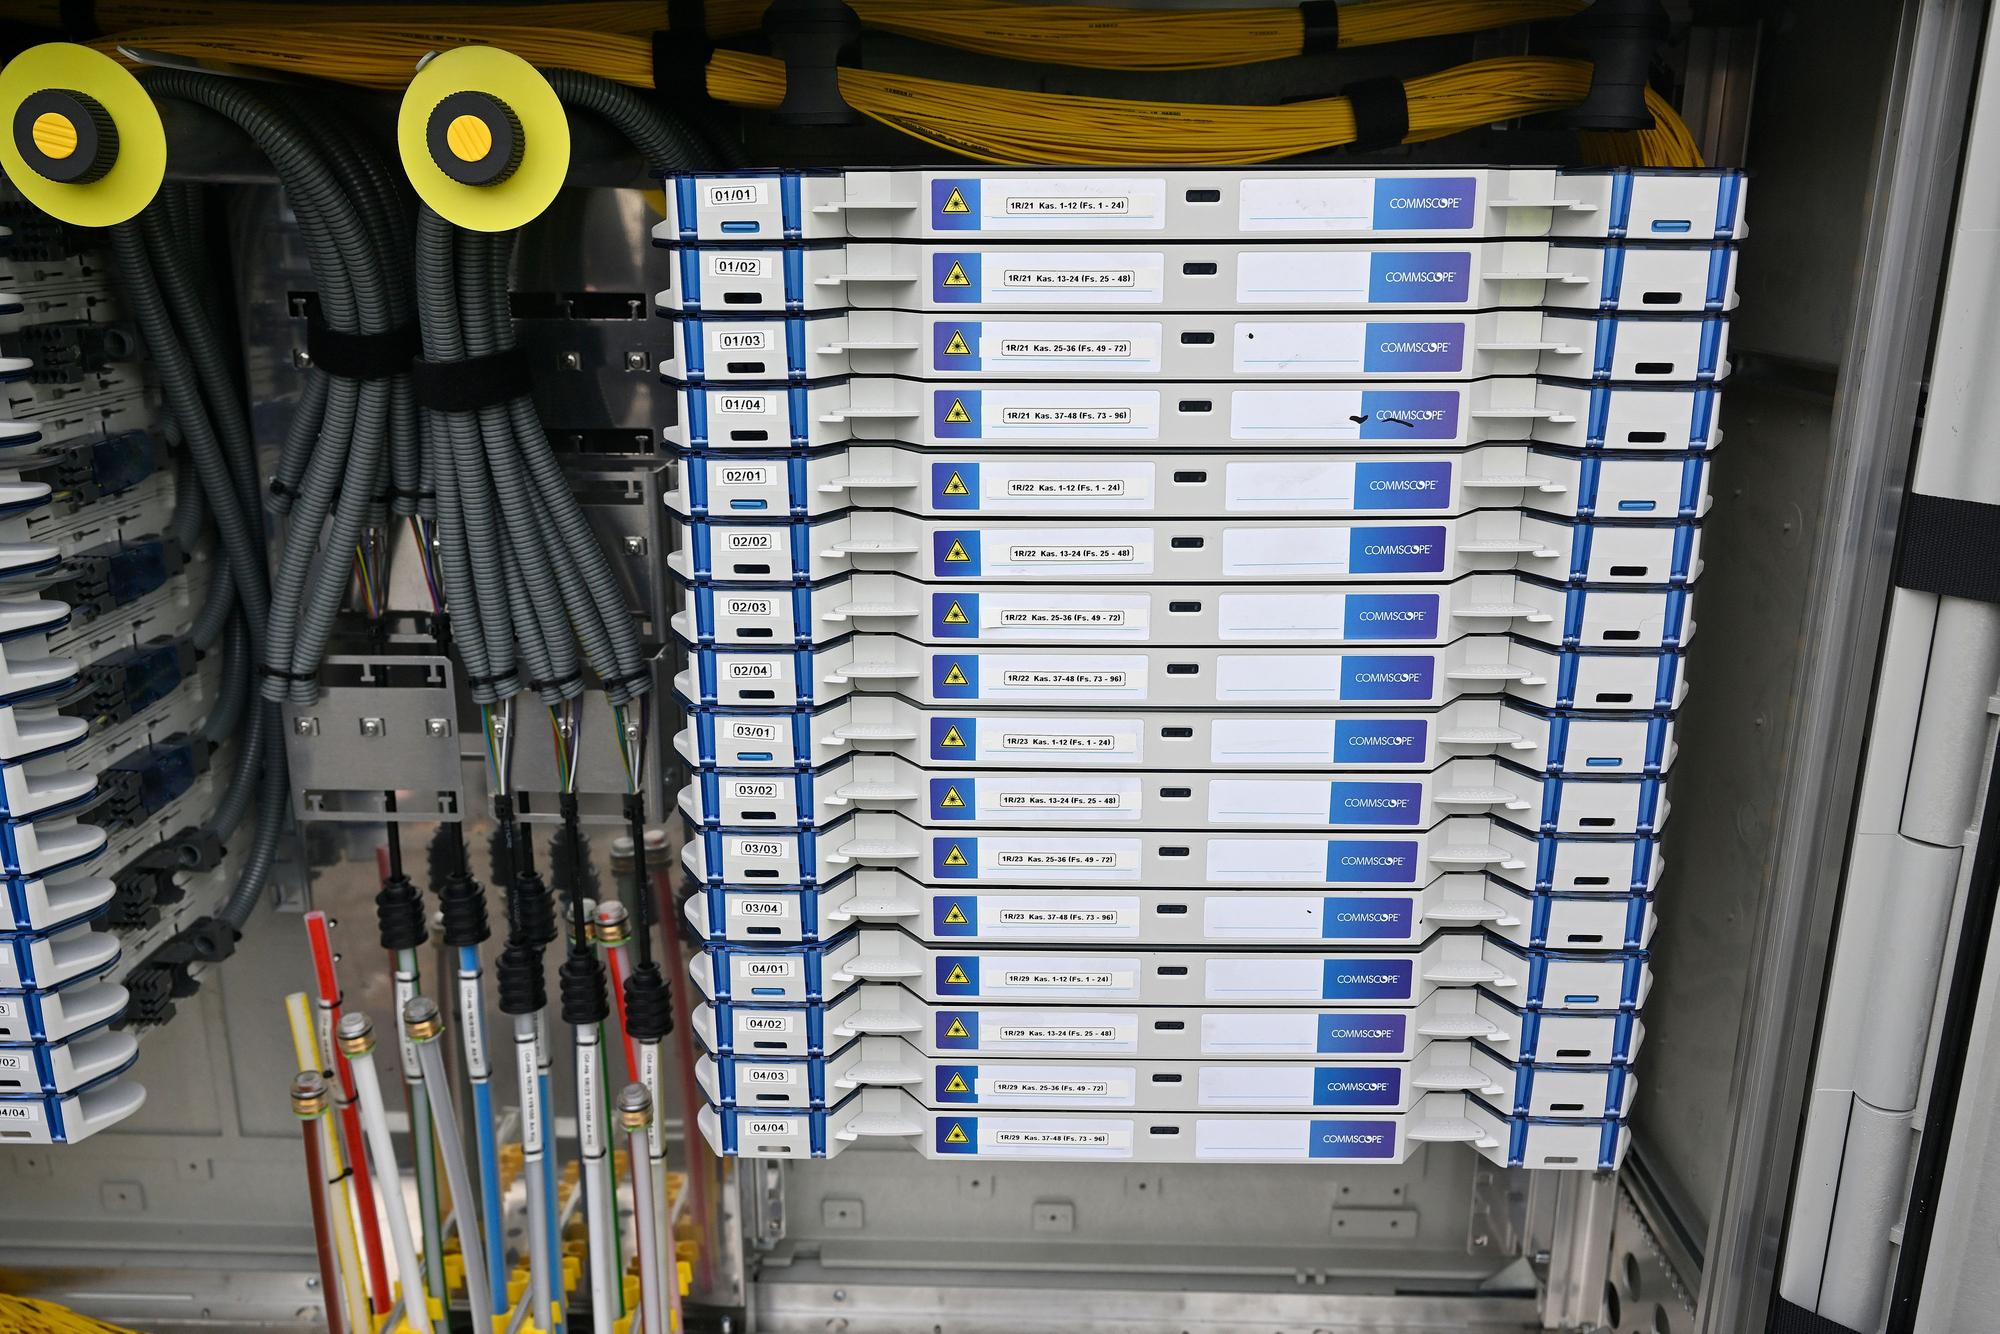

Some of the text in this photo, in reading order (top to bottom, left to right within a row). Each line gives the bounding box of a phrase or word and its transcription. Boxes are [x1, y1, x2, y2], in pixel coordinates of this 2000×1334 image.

[715, 189, 750, 202] 01/01
[1010, 202, 1034, 210] 1R/21
[1039, 202, 1057, 210] Kas.
[1059, 202, 1078, 210] 1-12
[1079, 201, 1096, 210] (Fs.
[1111, 200, 1124, 209] 24)
[1390, 198, 1462, 209] COMMSCOPE
[719, 261, 756, 273] 01/02
[1008, 274, 1031, 282] 1R/21
[1036, 274, 1055, 282] Kas.
[1081, 274, 1098, 283] (Fs.
[1099, 275, 1110, 283] 25
[1117, 274, 1131, 283] 48)
[1386, 272, 1456, 282] COMMSCOPE
[724, 335, 760, 347] 01/03
[1078, 344, 1094, 352] (Fs.
[1114, 344, 1127, 352] 72)
[1380, 342, 1451, 353] COMMSCOPE
[725, 399, 761, 410] 01/04
[1079, 411, 1095, 420] (Fs.
[1114, 411, 1127, 419] 96)
[1376, 410, 1446, 420] COMMSCOPE
[726, 470, 760, 482] 02/01
[1077, 484, 1093, 492] (Fs.
[1107, 483, 1120, 492] 24)
[1370, 480, 1438, 490] COMMSCOPE
[732, 536, 768, 547] 02/02
[1083, 549, 1098, 557] (Fs.
[1117, 549, 1130, 557] 48)
[1364, 544, 1432, 555] COMMSCOPE
[732, 602, 767, 613] 02/03
[1074, 613, 1089, 622] (Fs.
[1108, 614, 1121, 622] 72)
[1360, 611, 1426, 621] COMMSCOPE
[733, 666, 768, 676] 02/04
[1076, 674, 1092, 682] (Fs.
[1355, 673, 1422, 682] COMMSCOPE
[736, 726, 769, 738] 03/01
[1349, 736, 1415, 746] COMMSCOPE
[739, 785, 773, 796] 03/02
[1344, 798, 1410, 808] COMMSCOPE
[744, 843, 778, 854] 03/03
[1341, 856, 1405, 866] COMMSCOPE
[745, 903, 778, 914] 03/04
[1337, 913, 1400, 922] COMMSCOPE
[752, 964, 783, 974] 04/01
[1337, 975, 1400, 984] COMMSCOPE
[750, 1019, 782, 1029] 04/02
[1331, 1029, 1394, 1038] COMMSCOPE
[753, 1072, 784, 1081] 04/03
[1327, 1082, 1389, 1091] COMMSCOPE
[0, 1108, 25, 1117] 4/04
[753, 1123, 784, 1132] 04/04
[1323, 1135, 1384, 1144] COMMSCOPE
